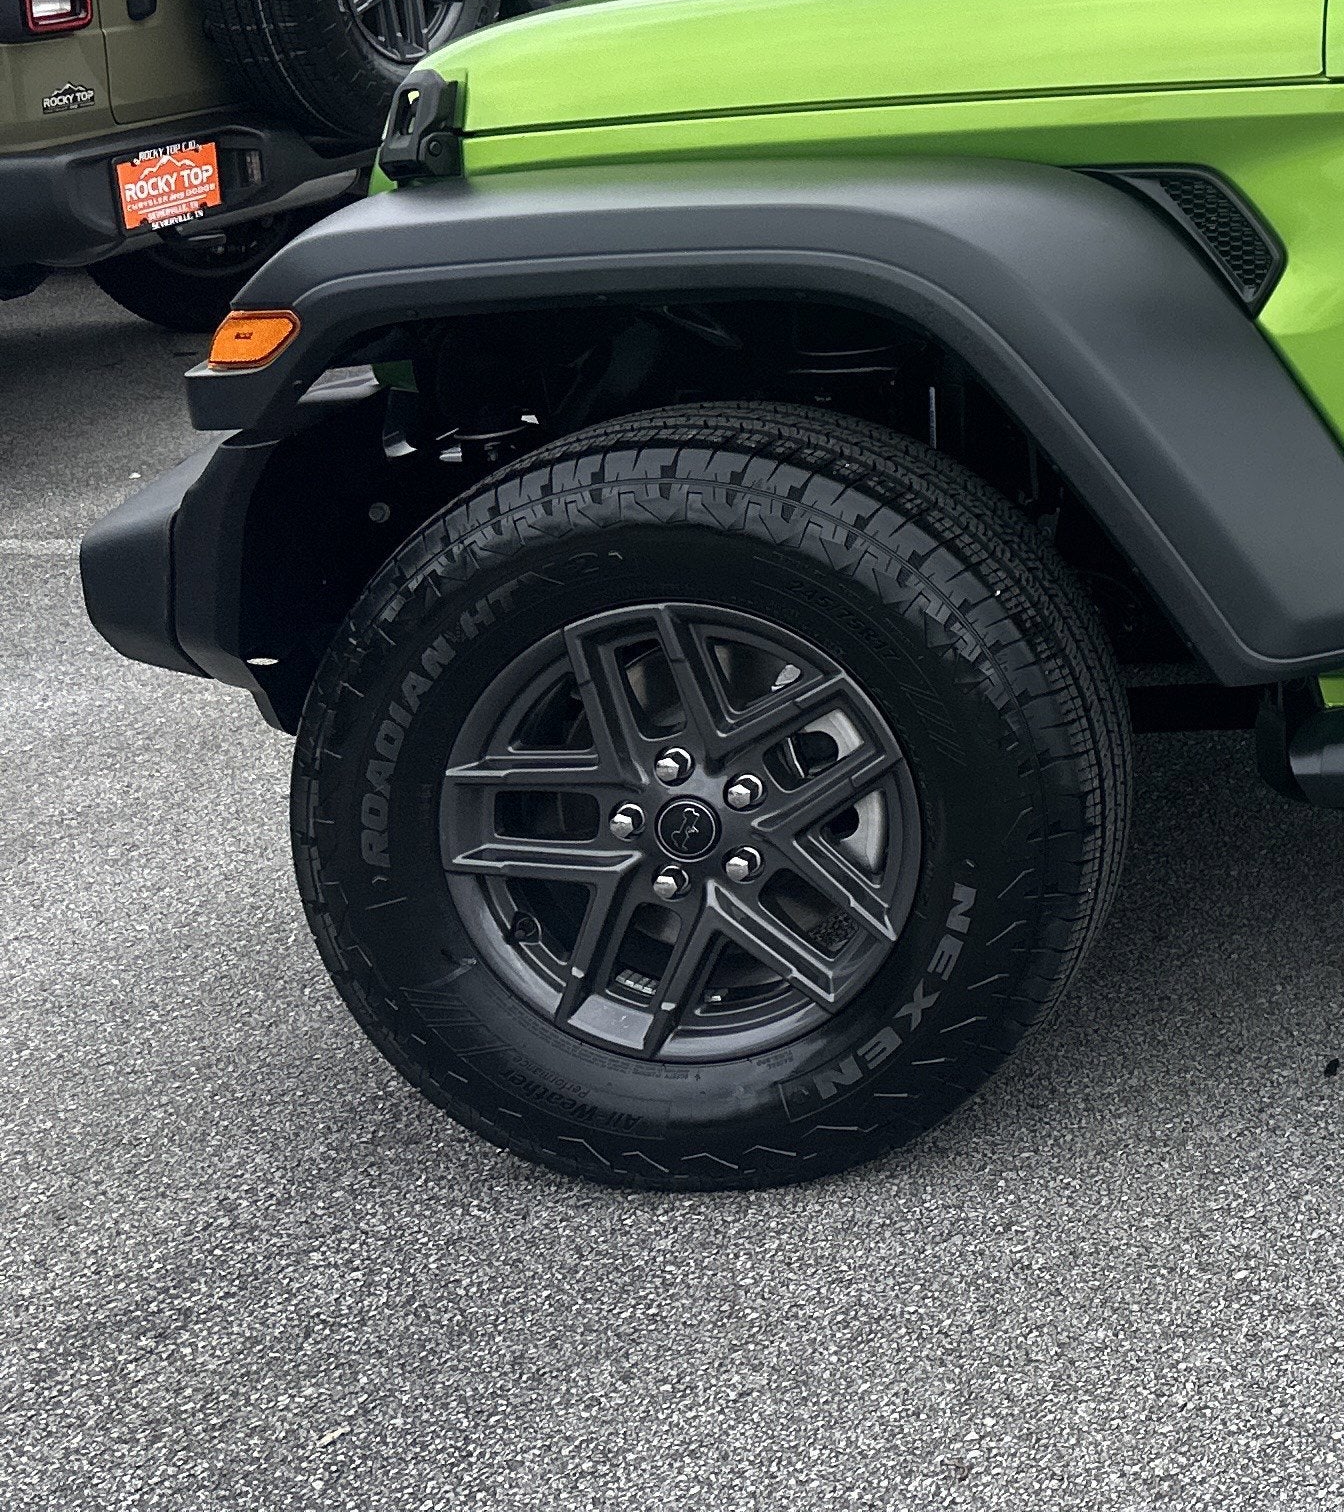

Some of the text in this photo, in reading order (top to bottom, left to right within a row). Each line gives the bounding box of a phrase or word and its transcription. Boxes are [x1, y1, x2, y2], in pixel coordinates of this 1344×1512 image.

[43, 90, 94, 108] ROCKY TOP
[124, 164, 214, 202] ROCKY TOP
[360, 633, 456, 869] ROADIAN
[812, 881, 978, 1101] NEXEN
[501, 1069, 642, 1131] All-Weather
